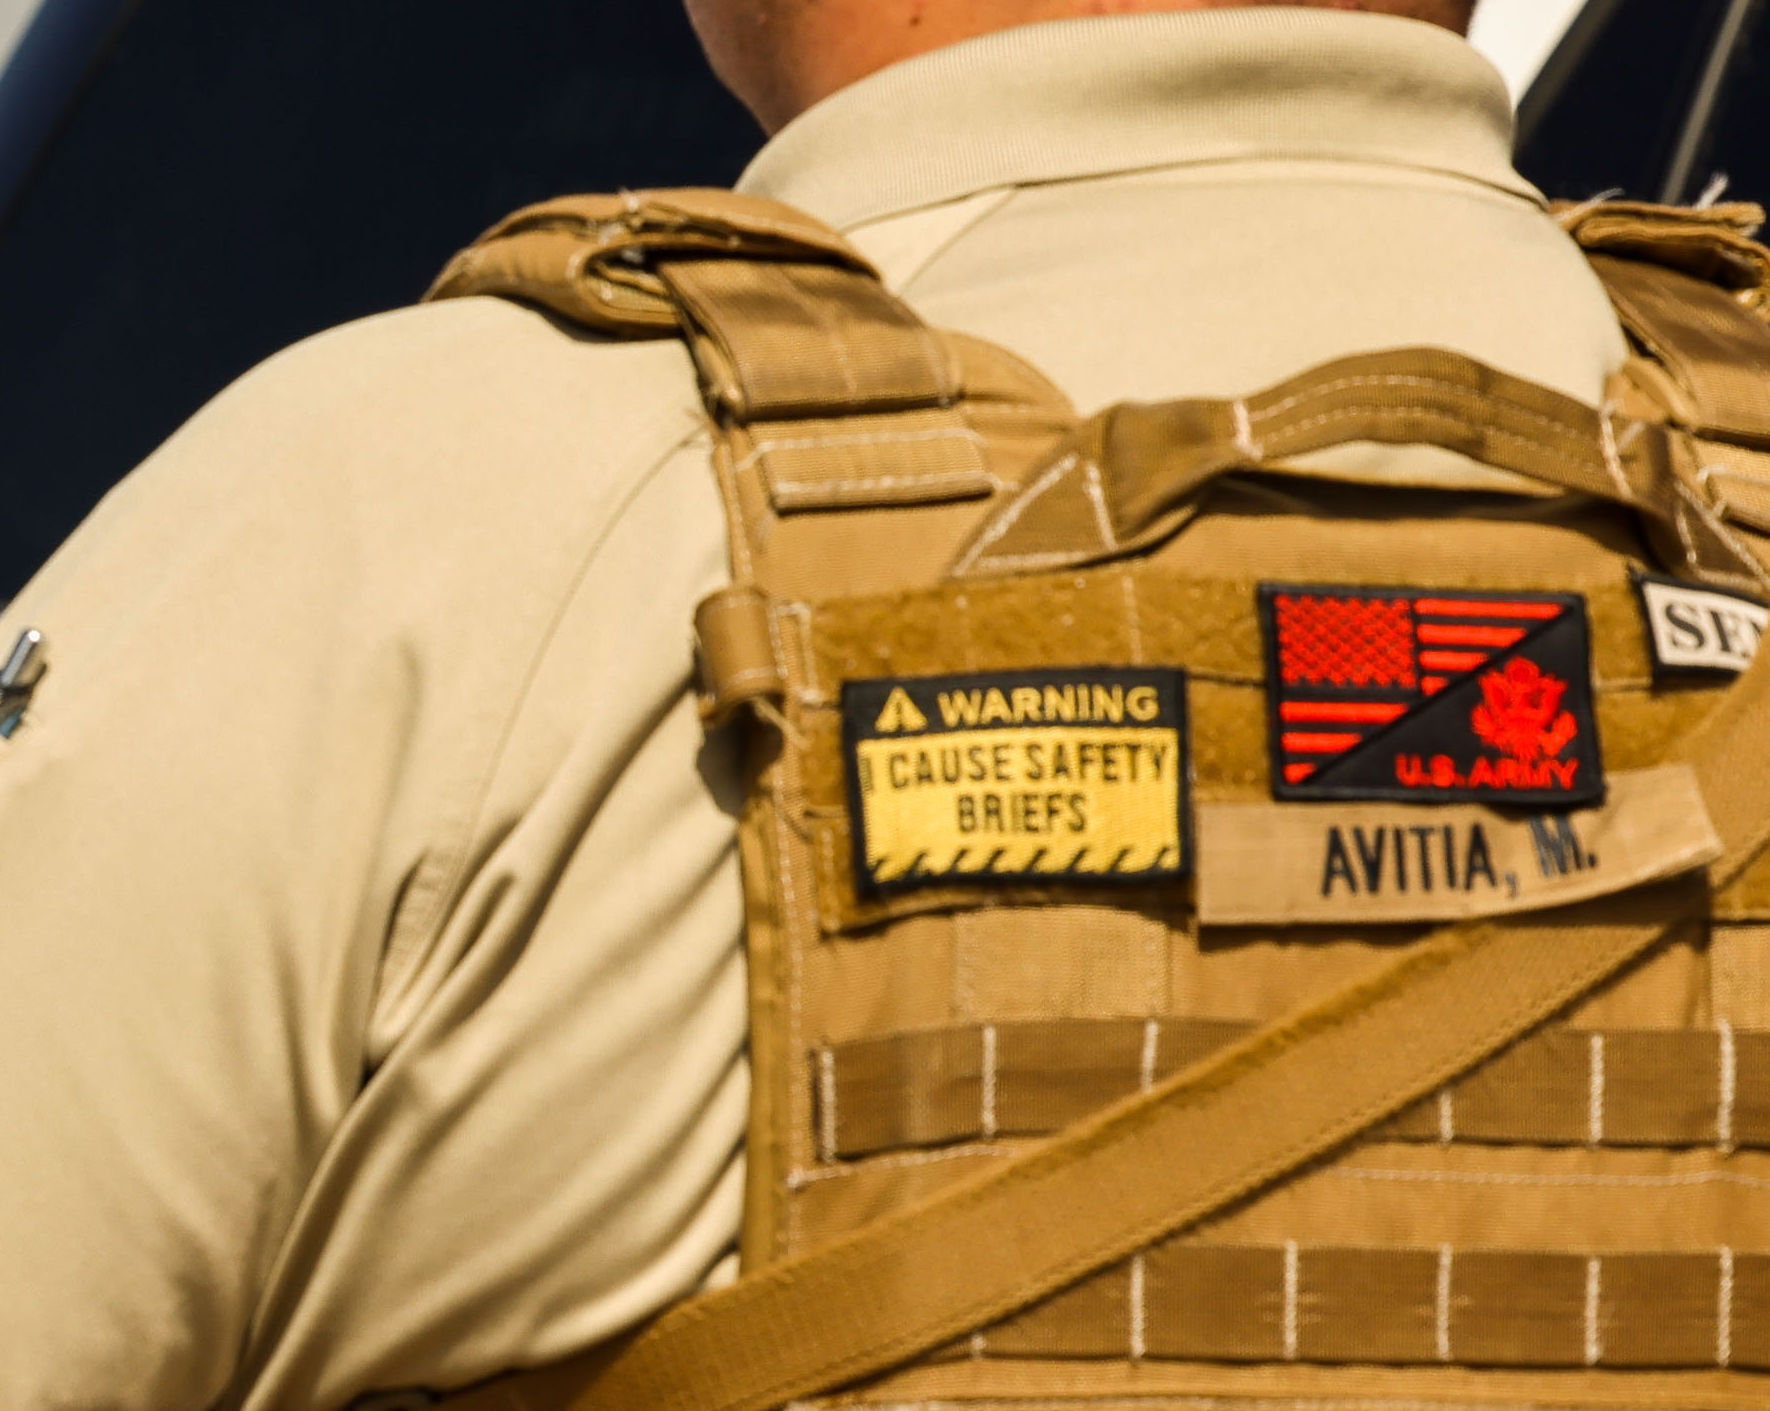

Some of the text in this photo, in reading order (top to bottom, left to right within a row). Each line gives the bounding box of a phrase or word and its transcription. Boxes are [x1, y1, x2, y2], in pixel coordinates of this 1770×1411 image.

[937, 683, 1159, 727] WARNING
[889, 744, 1010, 790] CAUSE
[1026, 742, 1167, 785] SAFETY
[958, 792, 1087, 834] BRIEFS
[1321, 814, 1597, 899] AVITIA, M.
